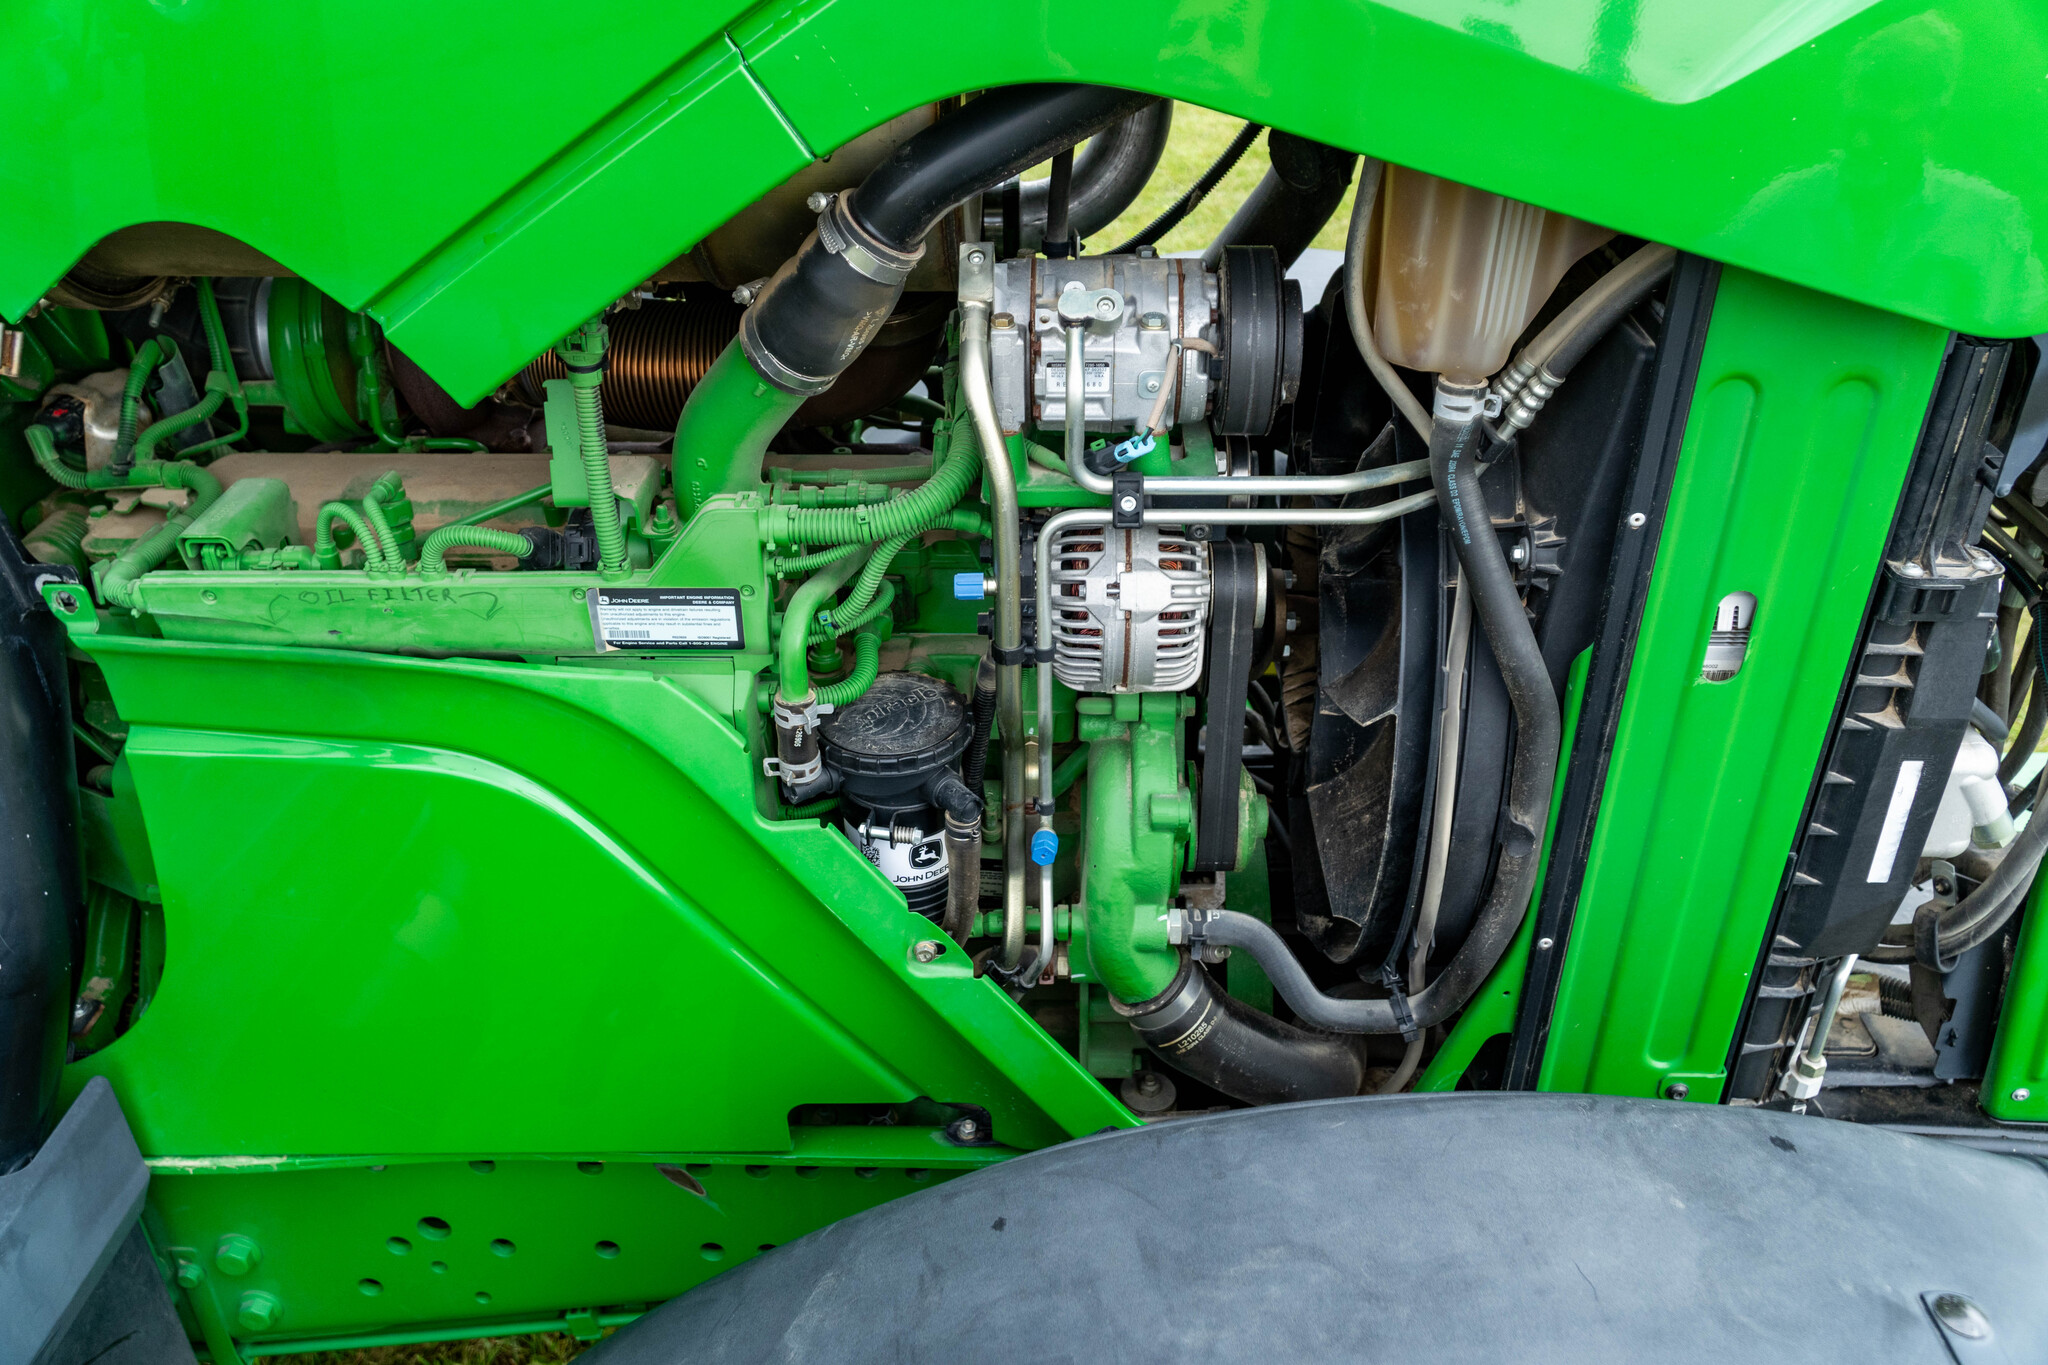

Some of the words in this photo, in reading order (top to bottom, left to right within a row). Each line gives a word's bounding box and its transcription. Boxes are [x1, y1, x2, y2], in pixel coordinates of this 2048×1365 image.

[1448, 474, 1457, 490] CLASS
[299, 589, 355, 605] OIL
[368, 586, 457, 603] FILTER
[925, 864, 949, 879] DEER
[1178, 1021, 1208, 1048] L210285
[1198, 1025, 1212, 1041] CLASS
